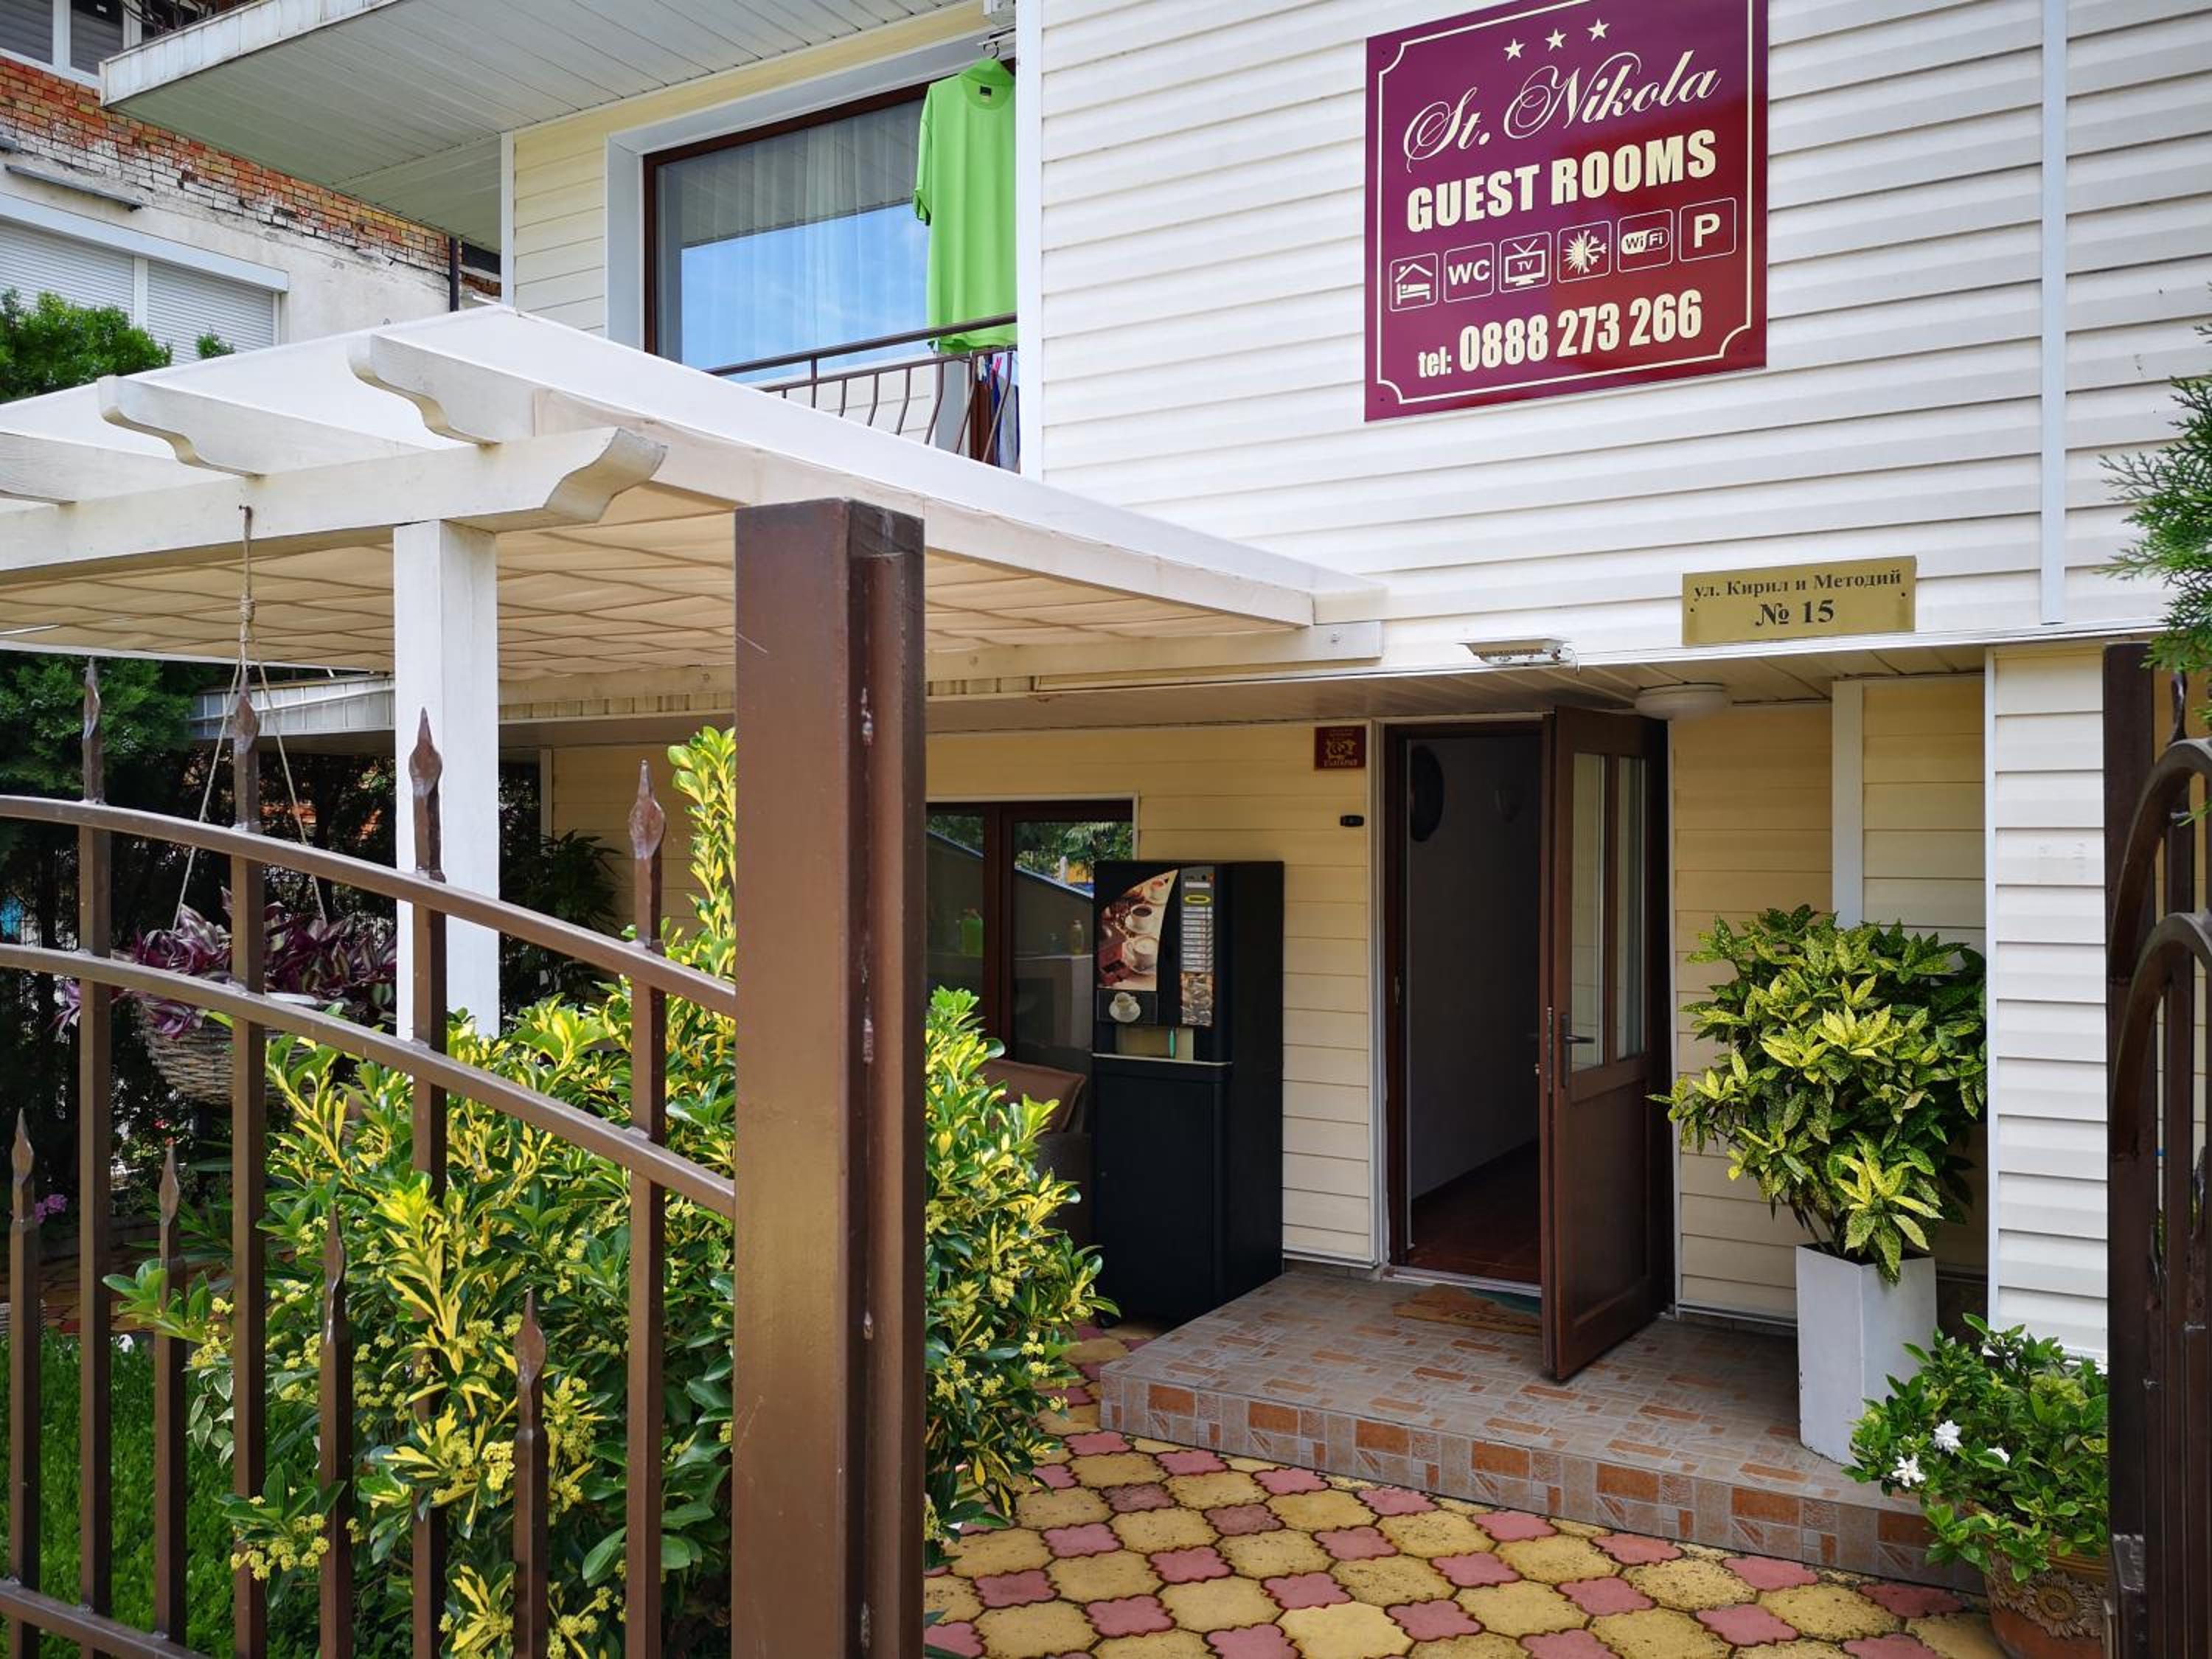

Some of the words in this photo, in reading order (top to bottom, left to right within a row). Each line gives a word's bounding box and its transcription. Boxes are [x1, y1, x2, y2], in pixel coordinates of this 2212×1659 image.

[1403, 86, 1490, 173] St.
[1503, 50, 1721, 139] Nikola
[1407, 164, 1541, 233] GUEST
[1551, 129, 1717, 206] ROOMS
[1624, 230, 1666, 251] WiFi
[1694, 213, 1720, 248] P
[1447, 259, 1492, 286] WC
[1517, 259, 1534, 271] TV
[1419, 346, 1452, 378] tel:
[1459, 314, 1549, 372] 0888
[1557, 302, 1620, 358] 273
[1629, 289, 1703, 347] 266
[1694, 585, 1719, 602] ул.
[1727, 580, 1788, 598] Кирил
[1795, 580, 1806, 591] и
[1814, 569, 1901, 590] Методий
[1804, 599, 1834, 623] 15
